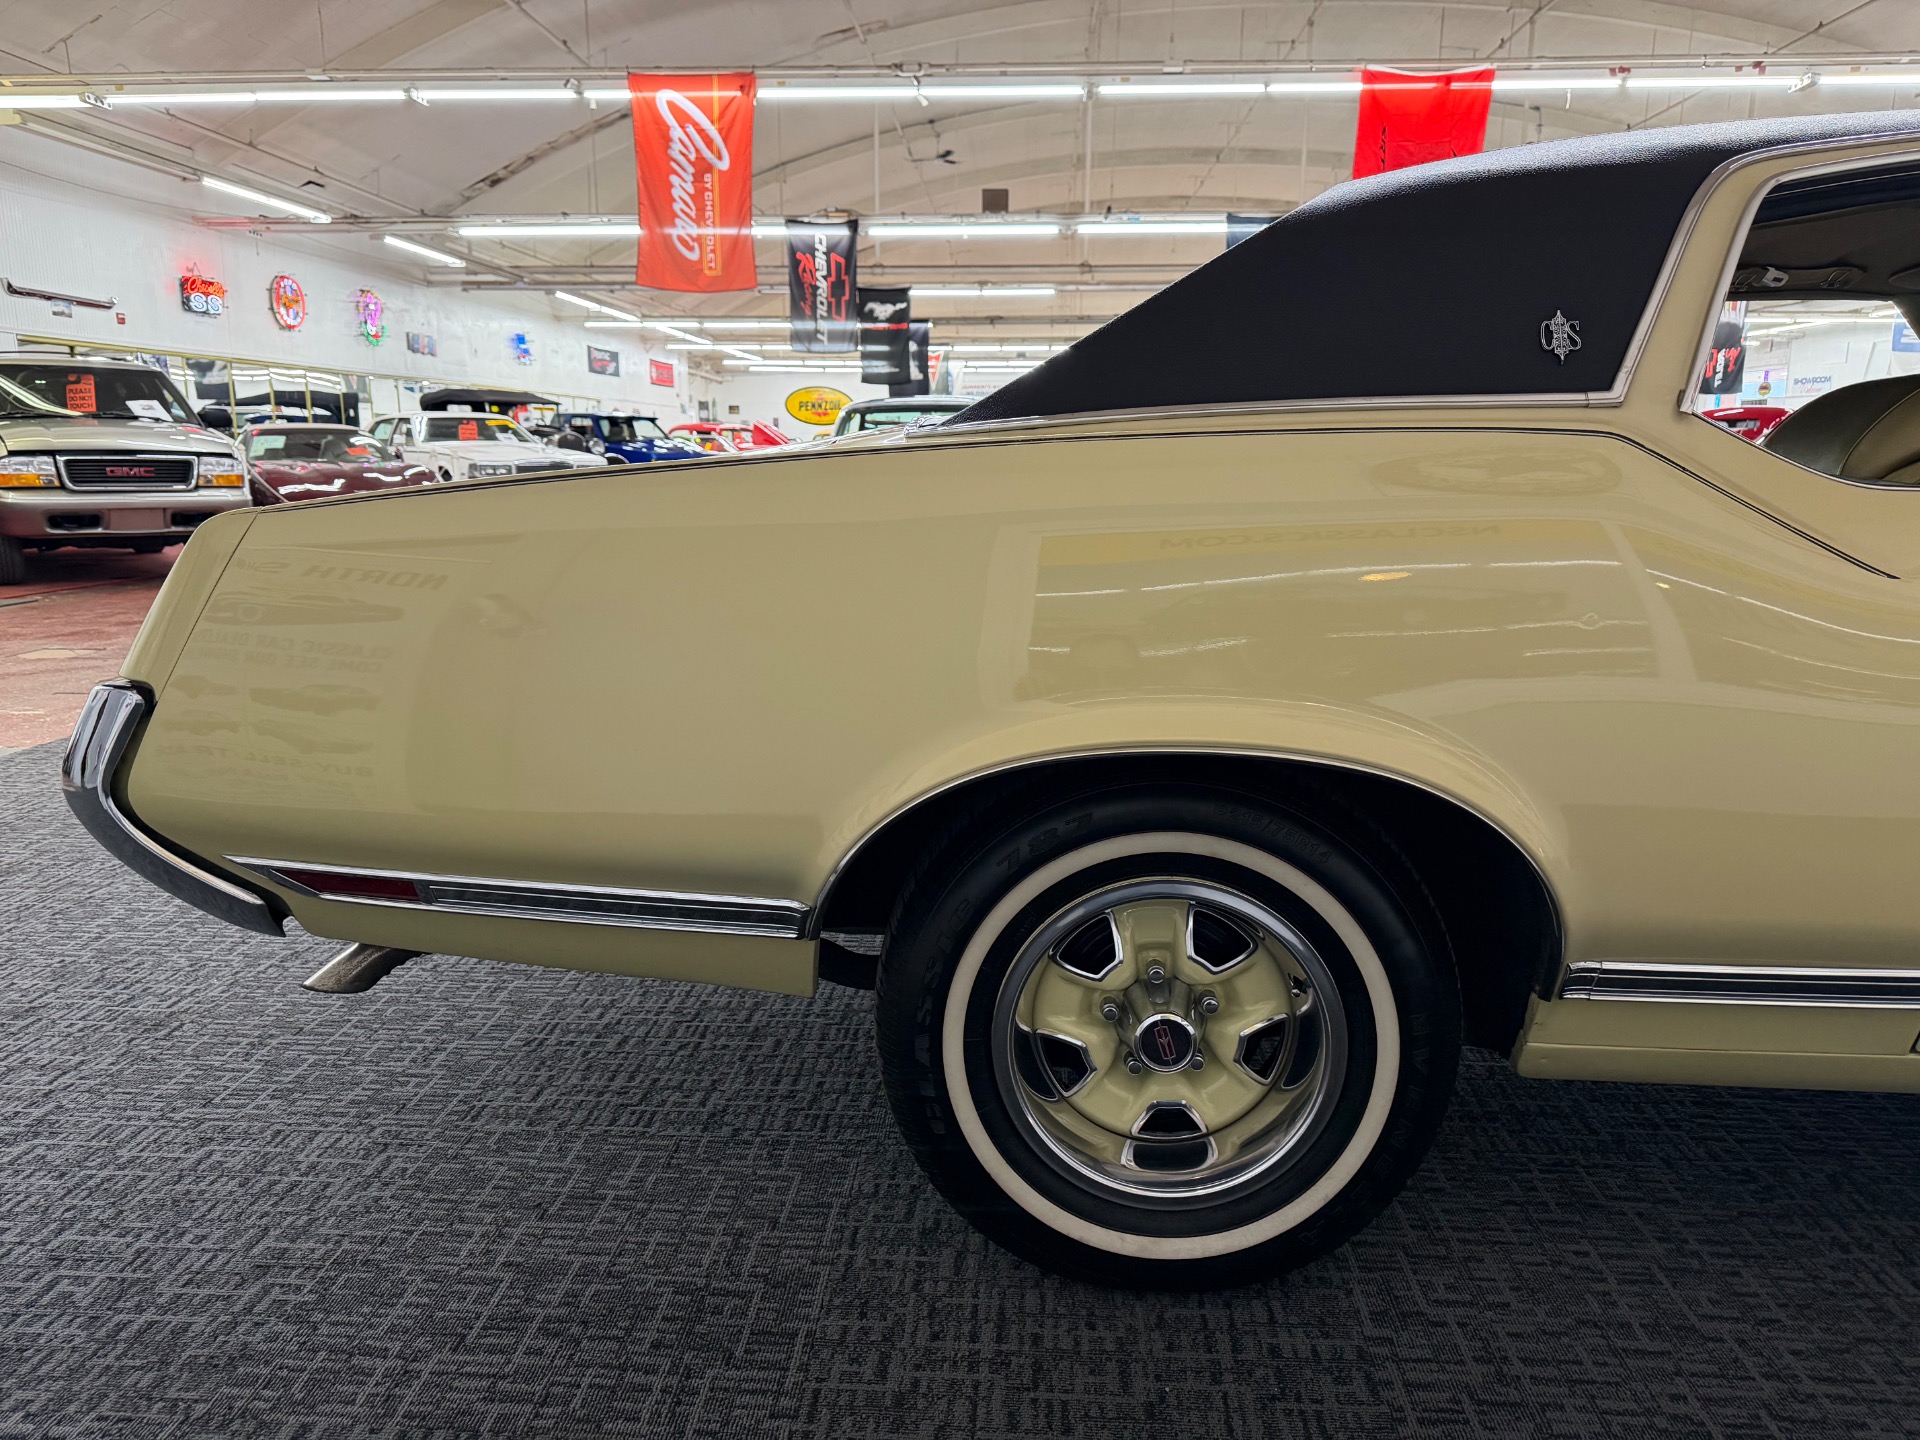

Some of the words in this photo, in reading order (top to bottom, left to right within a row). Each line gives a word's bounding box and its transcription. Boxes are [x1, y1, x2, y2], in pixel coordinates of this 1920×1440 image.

[655, 89, 730, 261] Camaro
[703, 173, 713, 189] BY
[703, 191, 716, 270] CHEVROLET
[189, 292, 223, 315] SS
[796, 251, 817, 316] Racing
[814, 232, 828, 345] CHEVROLET
[798, 400, 842, 412] PENNZOIL
[1793, 375, 1832, 385] SHOWROOM
[106, 467, 155, 477] GMC
[996, 811, 1094, 876] 787
[1214, 804, 1332, 864] P215/75R14
